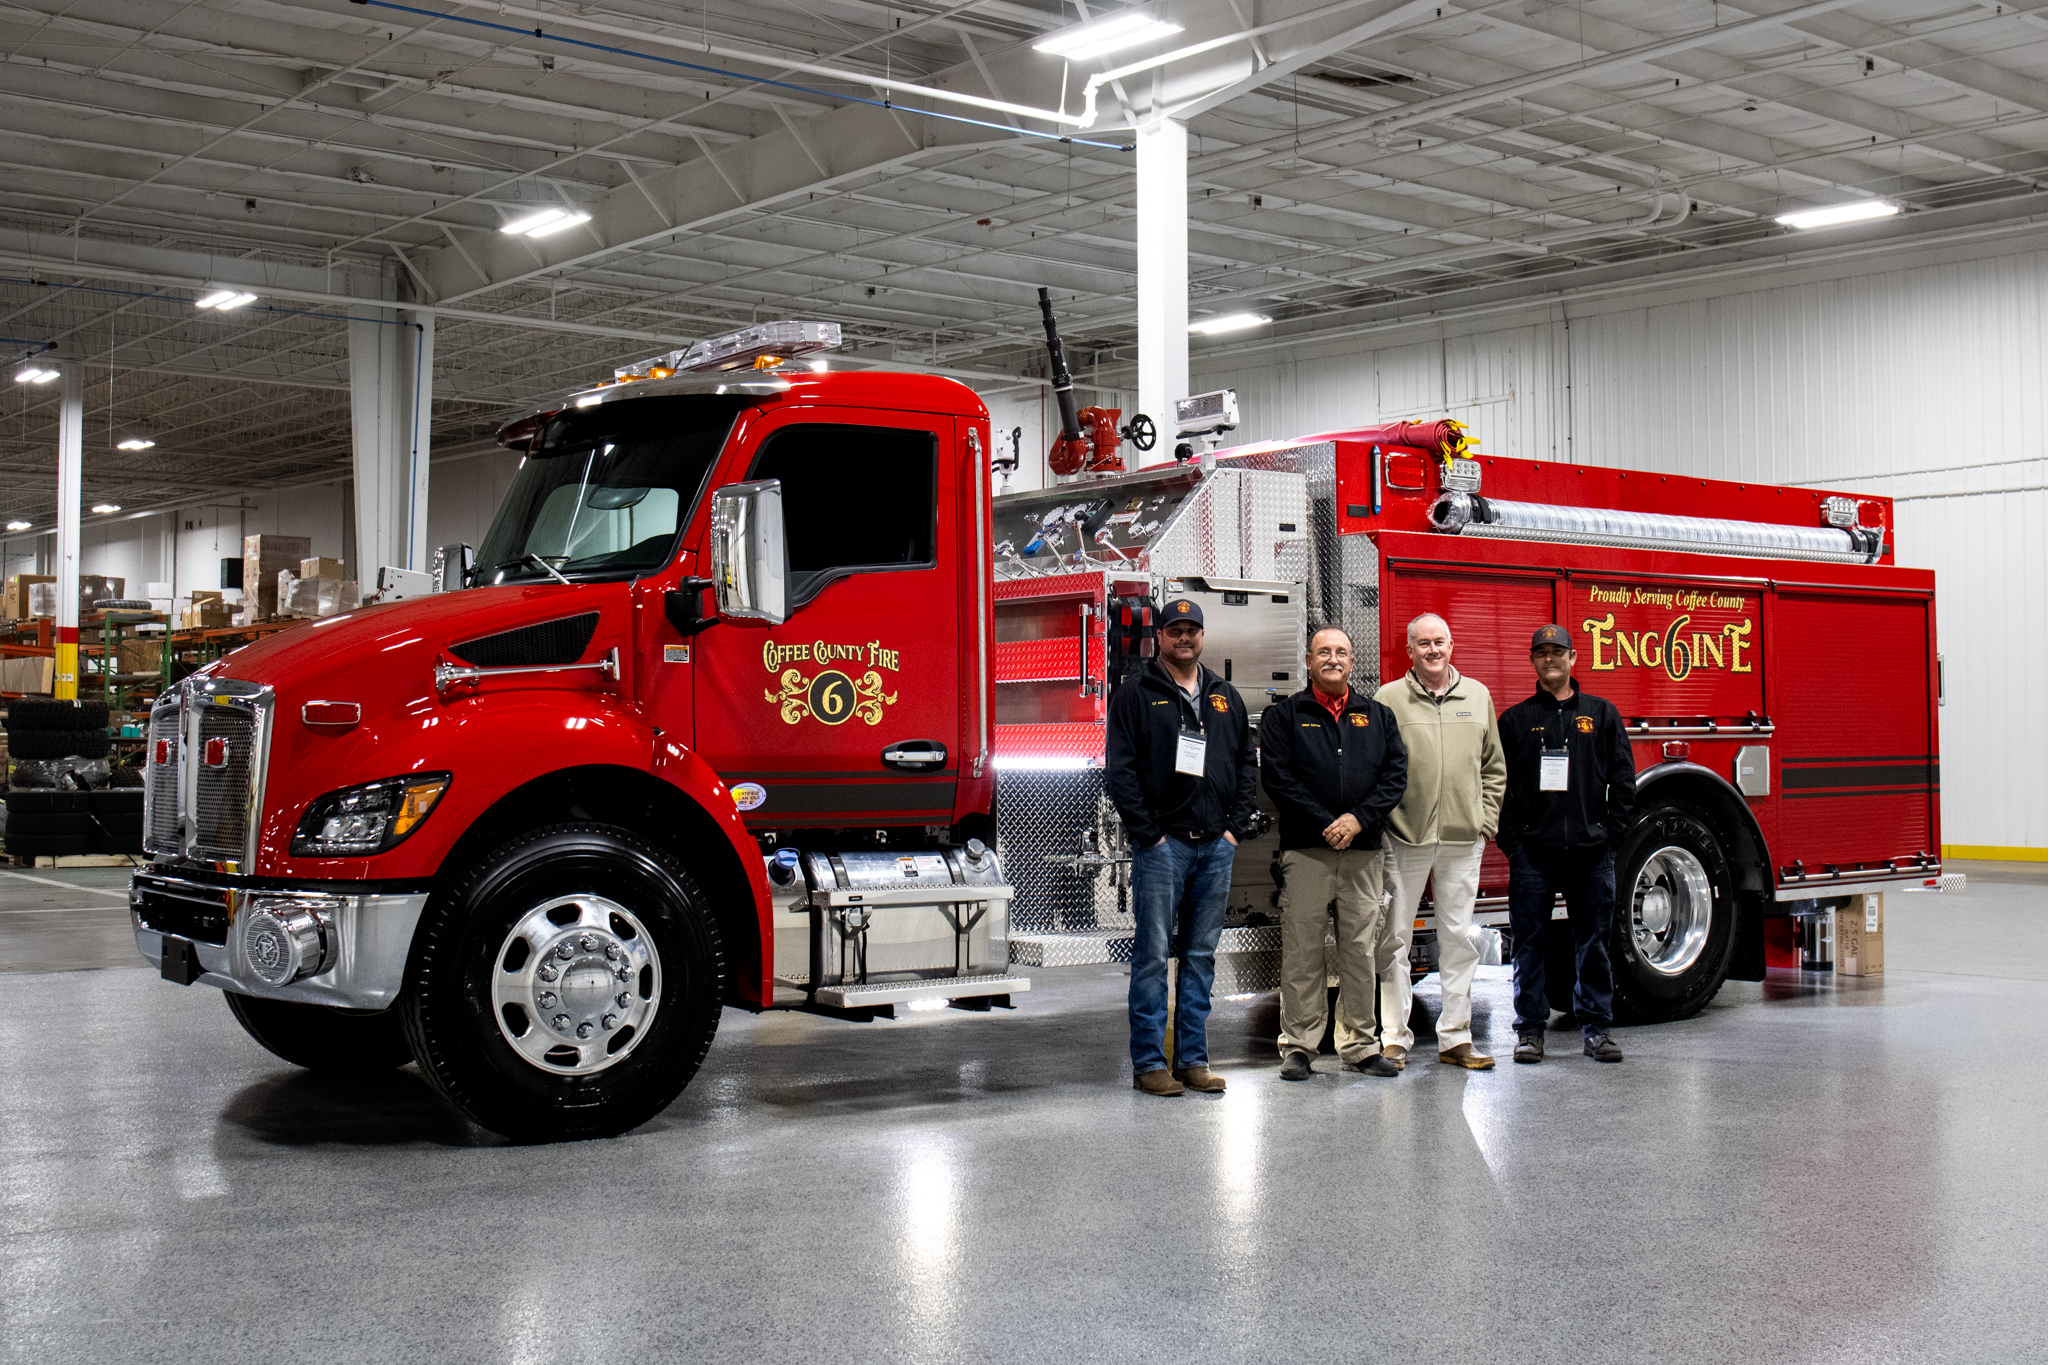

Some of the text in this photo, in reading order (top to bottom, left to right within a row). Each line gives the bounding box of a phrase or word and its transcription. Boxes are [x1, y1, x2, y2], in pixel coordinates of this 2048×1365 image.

[1589, 585, 1745, 613] Proudly Serving Coffee County
[762, 639, 900, 674] COFFEE COUNTY FIRE
[822, 680, 843, 715] 6
[1850, 920, 1858, 957] 2.5 GAL
